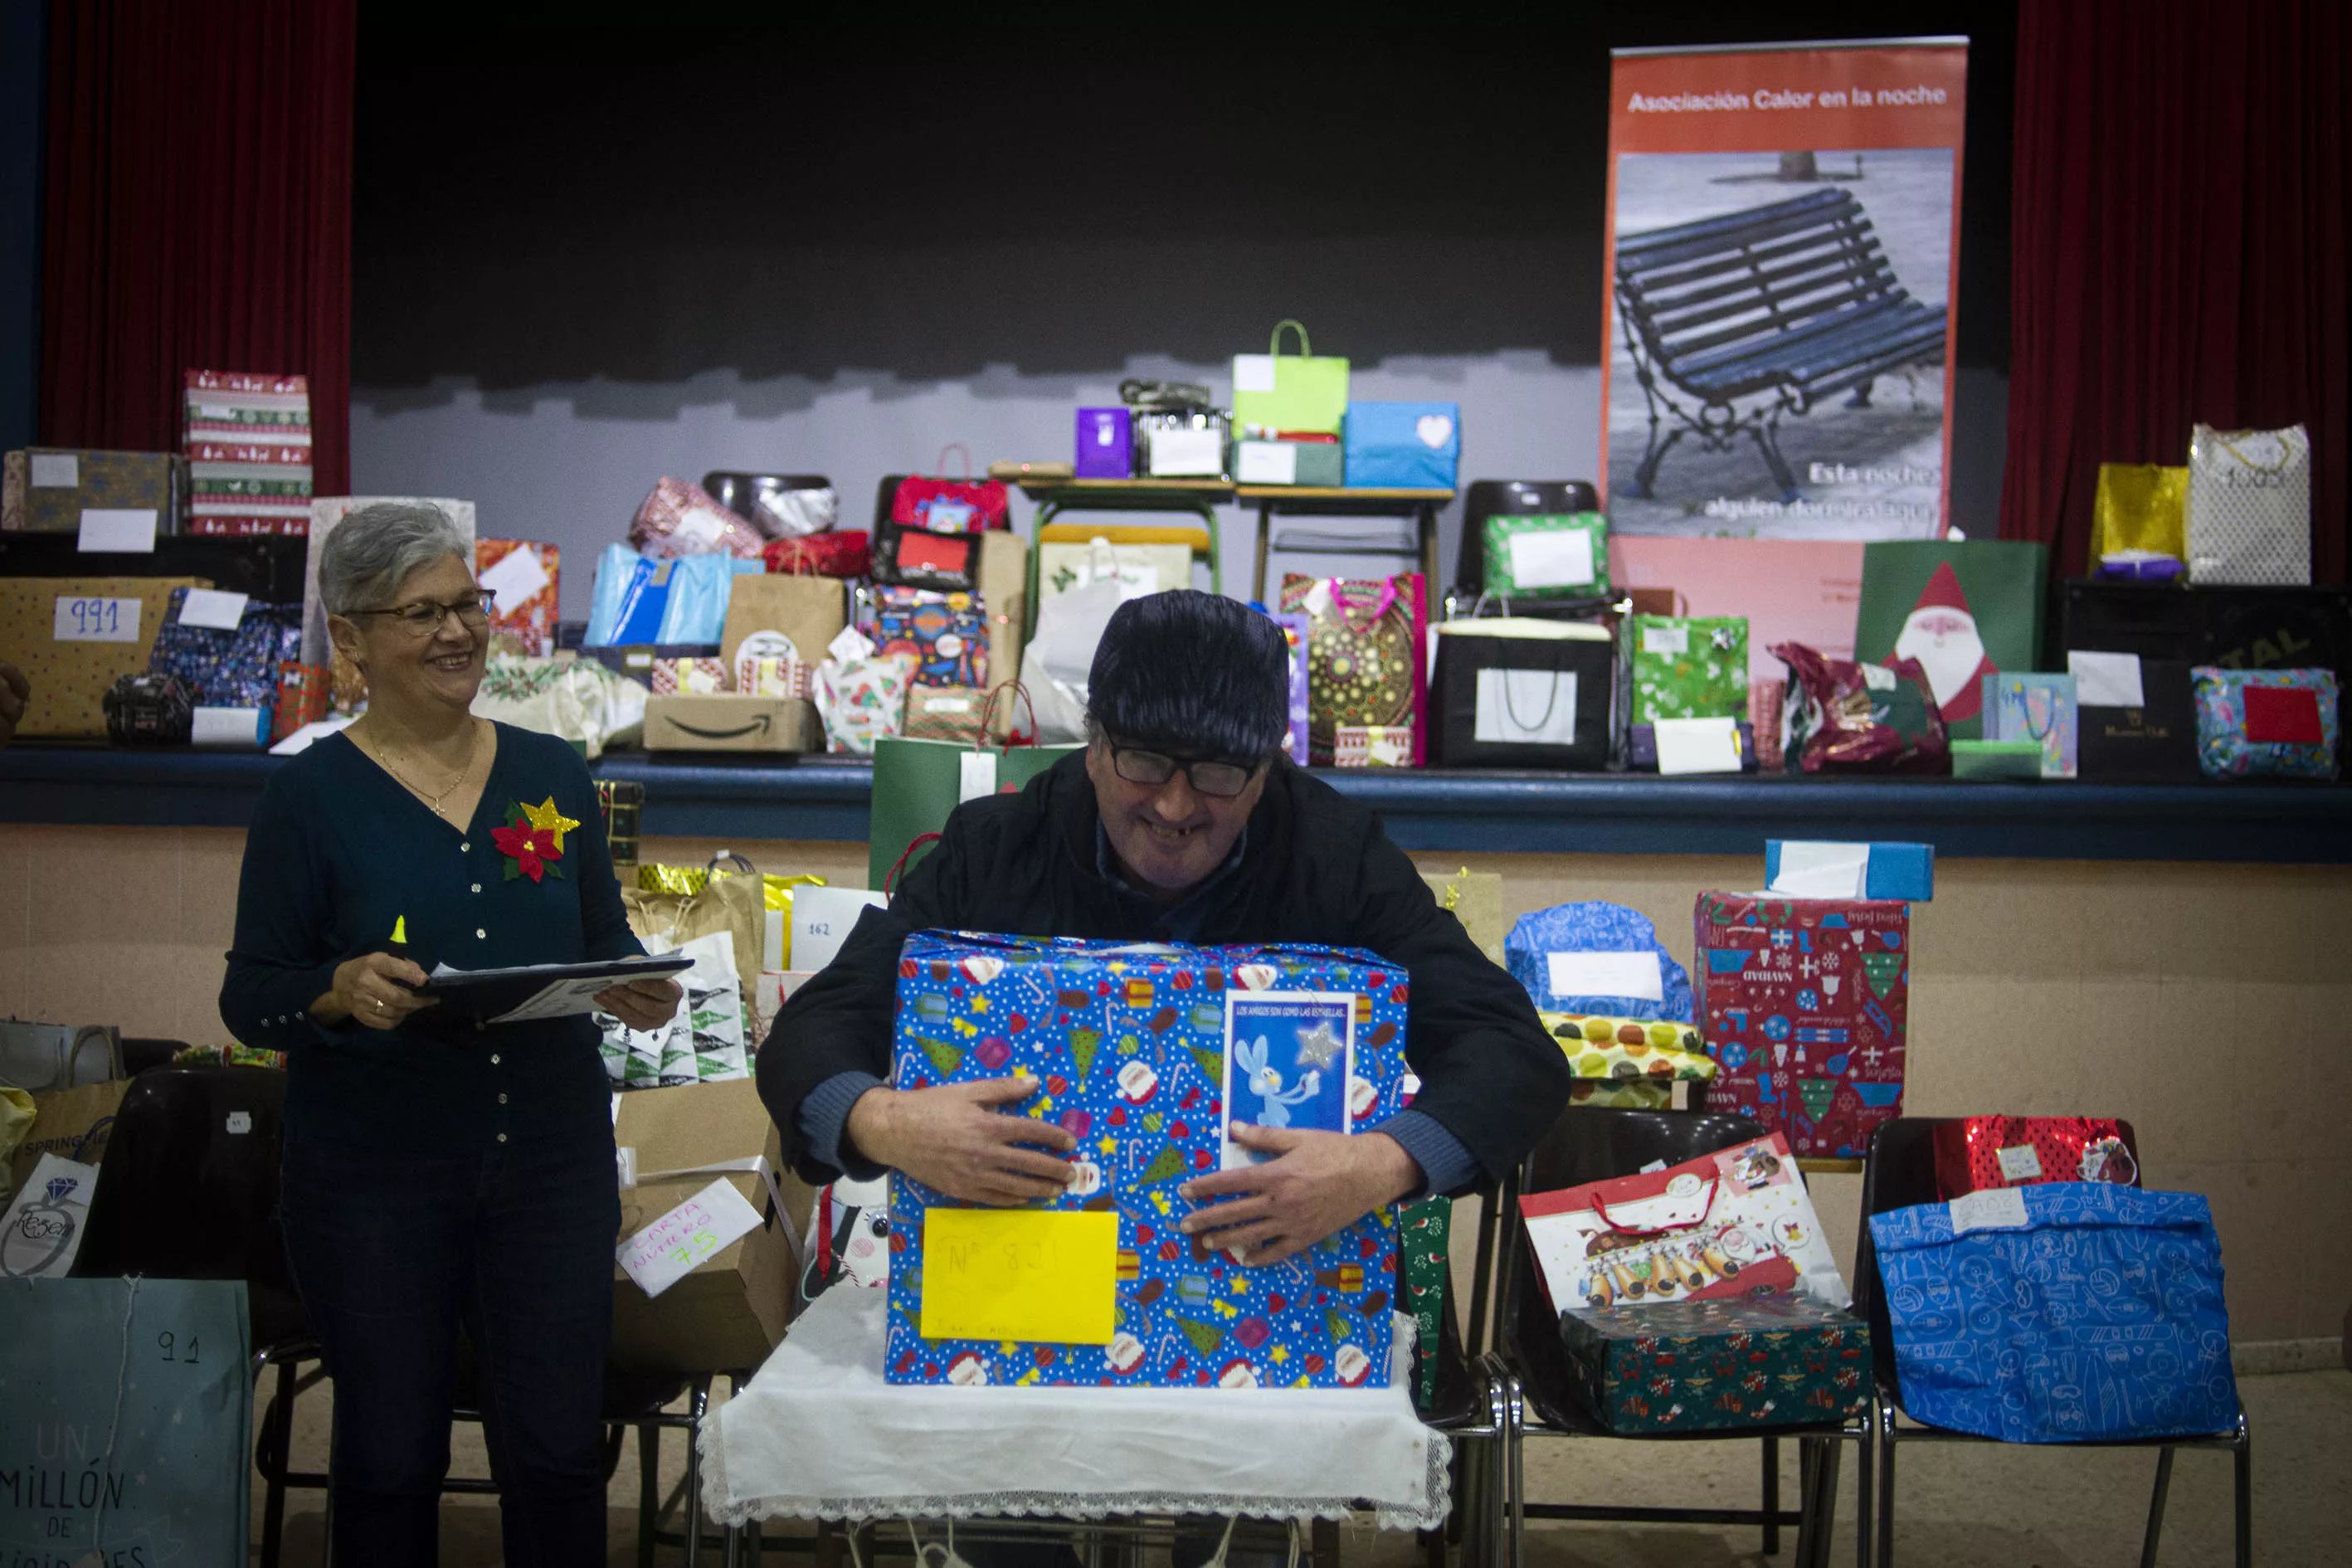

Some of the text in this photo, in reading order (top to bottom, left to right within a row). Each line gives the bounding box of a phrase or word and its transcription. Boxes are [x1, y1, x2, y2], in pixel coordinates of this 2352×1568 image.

[1627, 83, 1947, 114] Asociación Calor en la noche
[71, 598, 119, 633] 991
[2210, 627, 2312, 669] TAL
[809, 923, 830, 937] 162
[1743, 970, 1793, 983] NAVIDAD
[25, 1132, 109, 1156] SPRINGIE
[634, 1203, 699, 1249] CARTA
[669, 1226, 718, 1266] 75
[158, 1330, 200, 1364] 91
[36, 1422, 90, 1462] UN
[47, 1516, 74, 1538] DE
